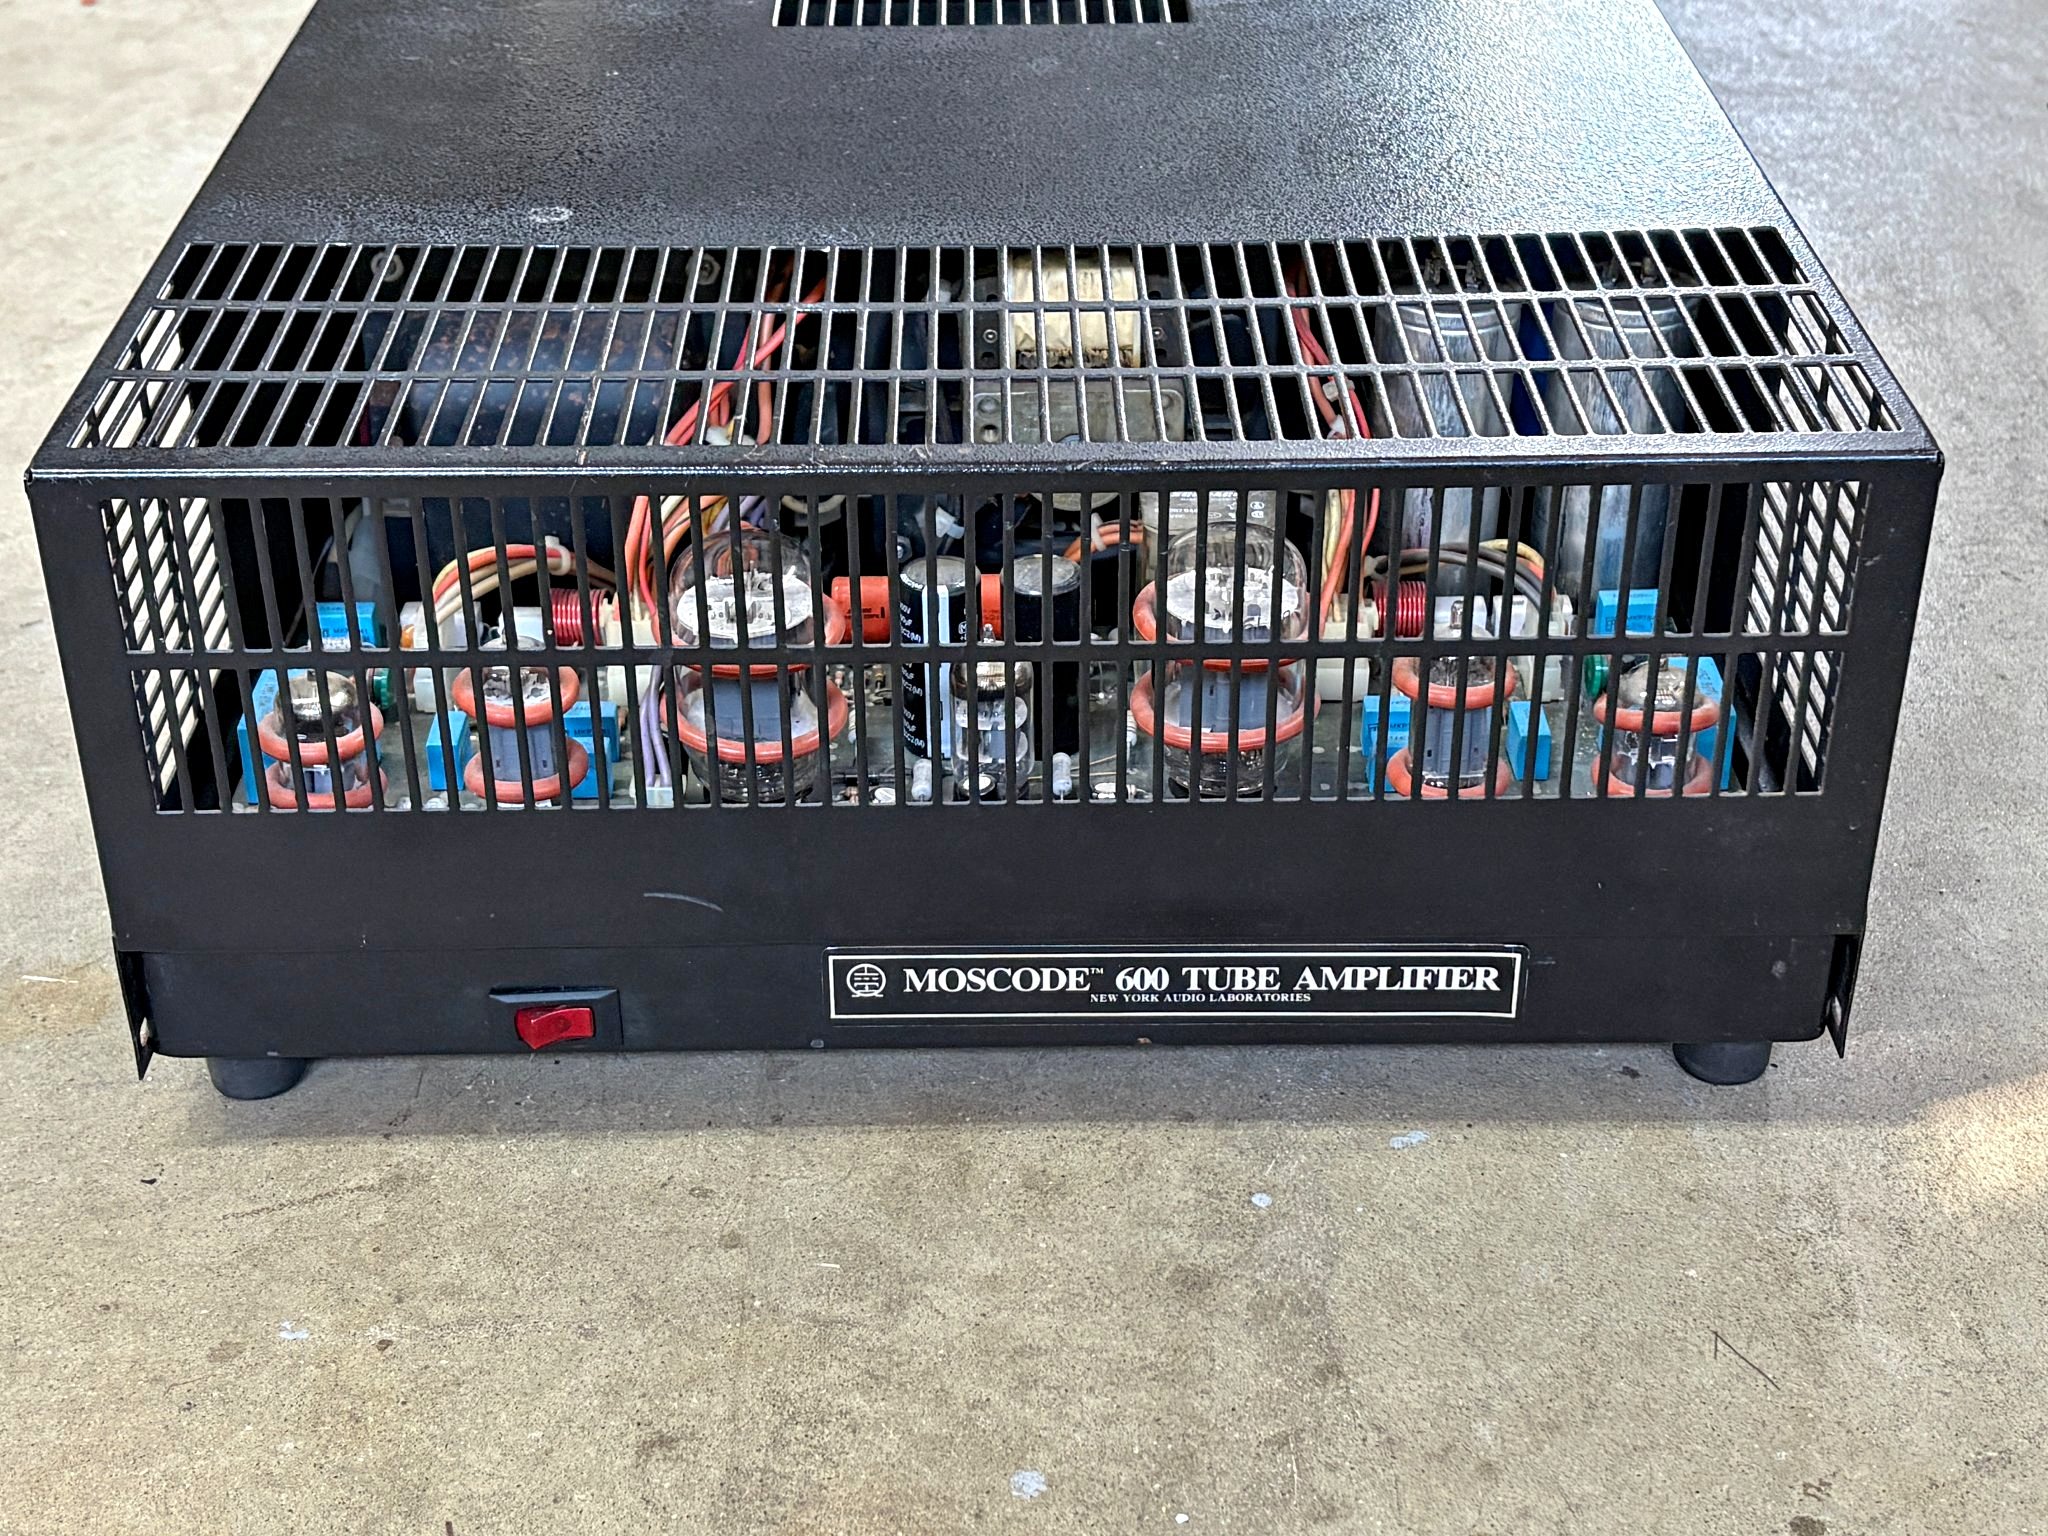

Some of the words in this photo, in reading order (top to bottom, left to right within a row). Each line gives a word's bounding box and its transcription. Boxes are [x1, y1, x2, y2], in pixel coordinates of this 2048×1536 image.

[1115, 966, 1170, 992] 600
[1182, 966, 1281, 991] TUBE
[1292, 966, 1501, 991] AMPLIFIER
[1090, 993, 1119, 1003] NEW
[1123, 993, 1160, 1003] YORK
[1164, 993, 1206, 1003] AUDIO
[1209, 993, 1312, 1003] LABORATORIES
